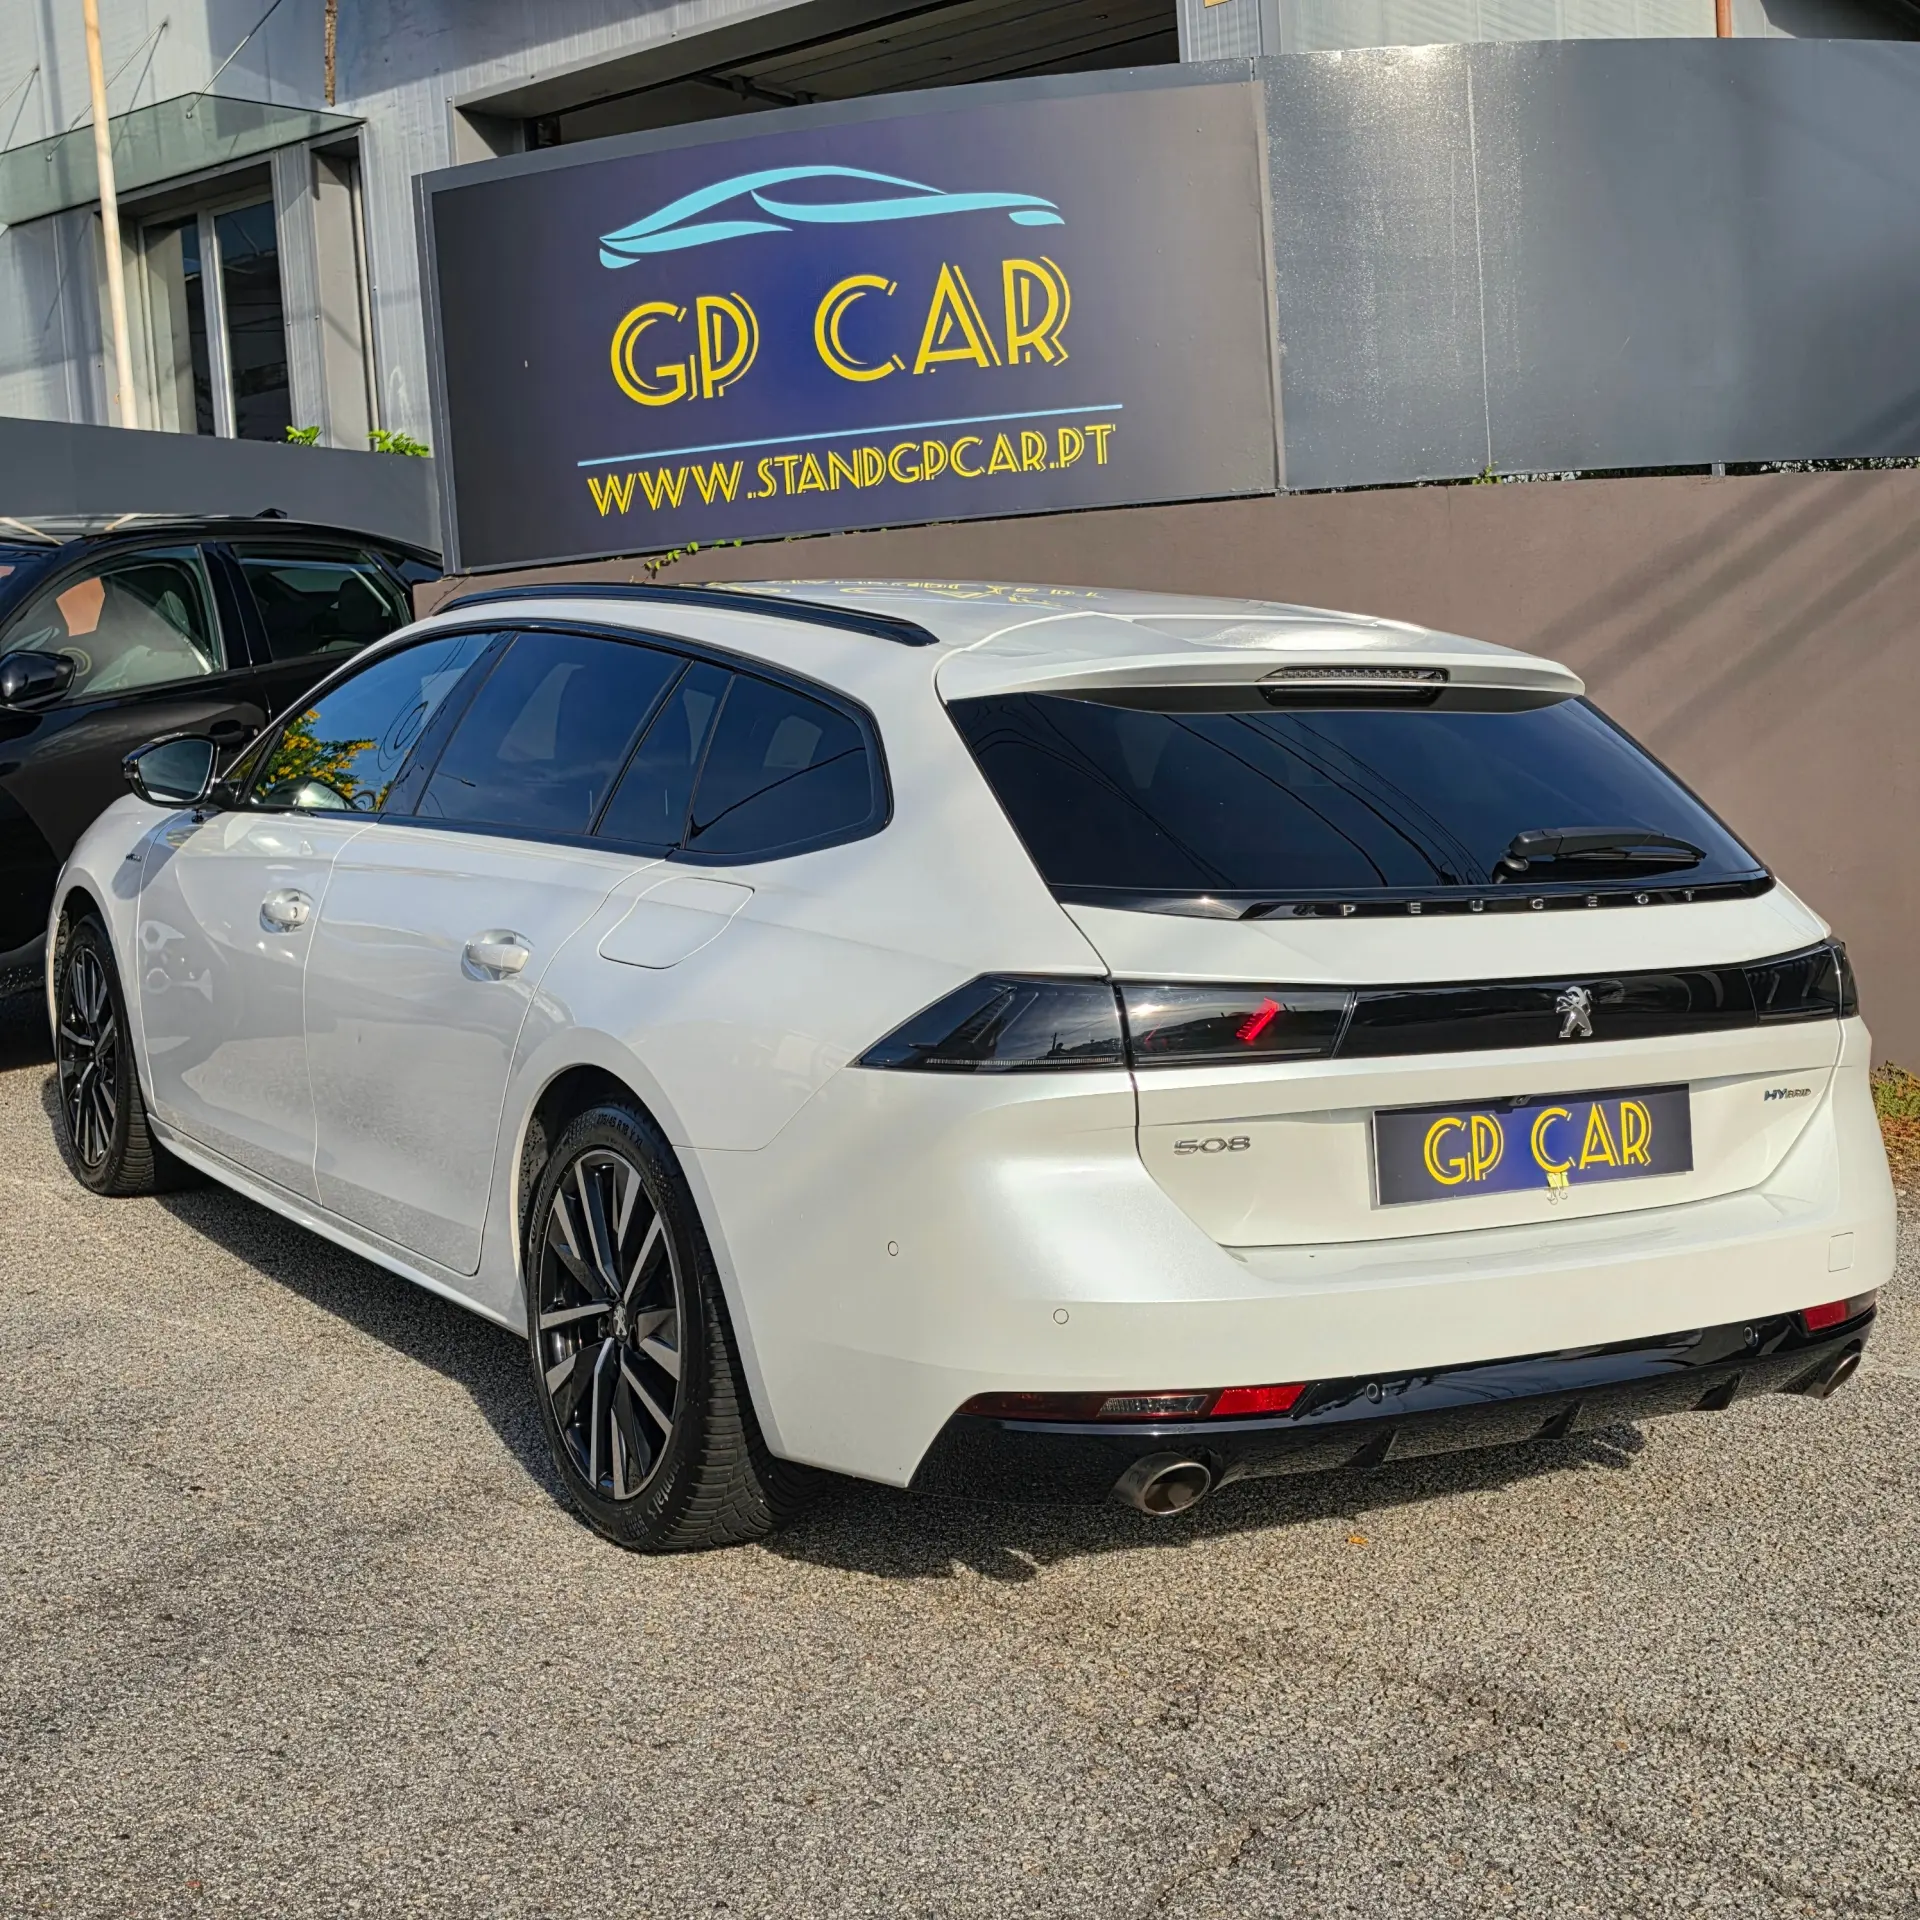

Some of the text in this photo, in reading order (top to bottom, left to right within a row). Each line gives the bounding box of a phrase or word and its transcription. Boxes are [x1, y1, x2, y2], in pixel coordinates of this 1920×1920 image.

[610, 255, 1072, 407] GP CAR
[586, 423, 1117, 518] WWW.STANDGPCAR.PT
[1341, 888, 1696, 917] PEUGEOT
[1763, 1088, 1812, 1102] HYBRID
[1173, 1135, 1252, 1156] 508
[1423, 1100, 1652, 1185] GP CAR
